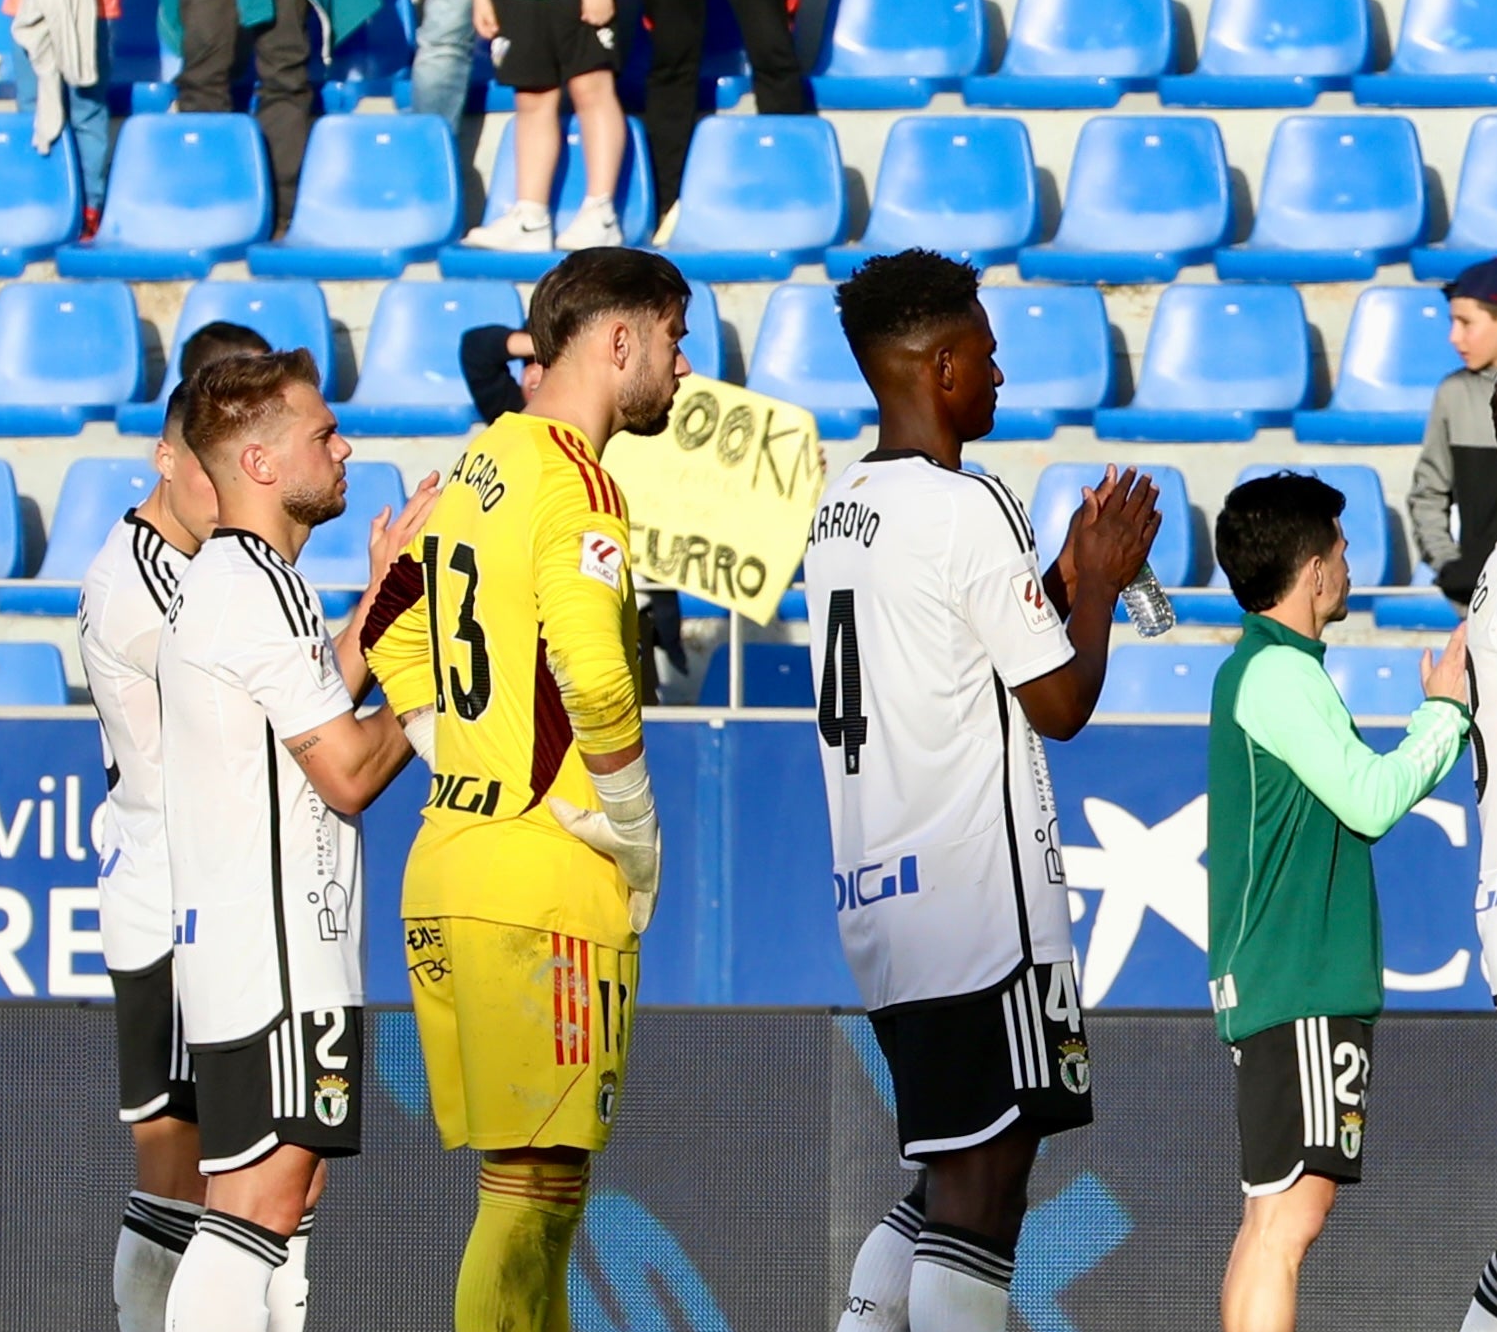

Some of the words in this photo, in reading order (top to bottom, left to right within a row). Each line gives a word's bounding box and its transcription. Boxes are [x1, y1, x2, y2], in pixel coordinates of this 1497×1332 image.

[805, 499, 881, 552] ARROYO
[422, 533, 494, 722] 13
[818, 588, 867, 775] 4
[1044, 962, 1081, 1033] 4
[312, 1007, 349, 1070] 2
